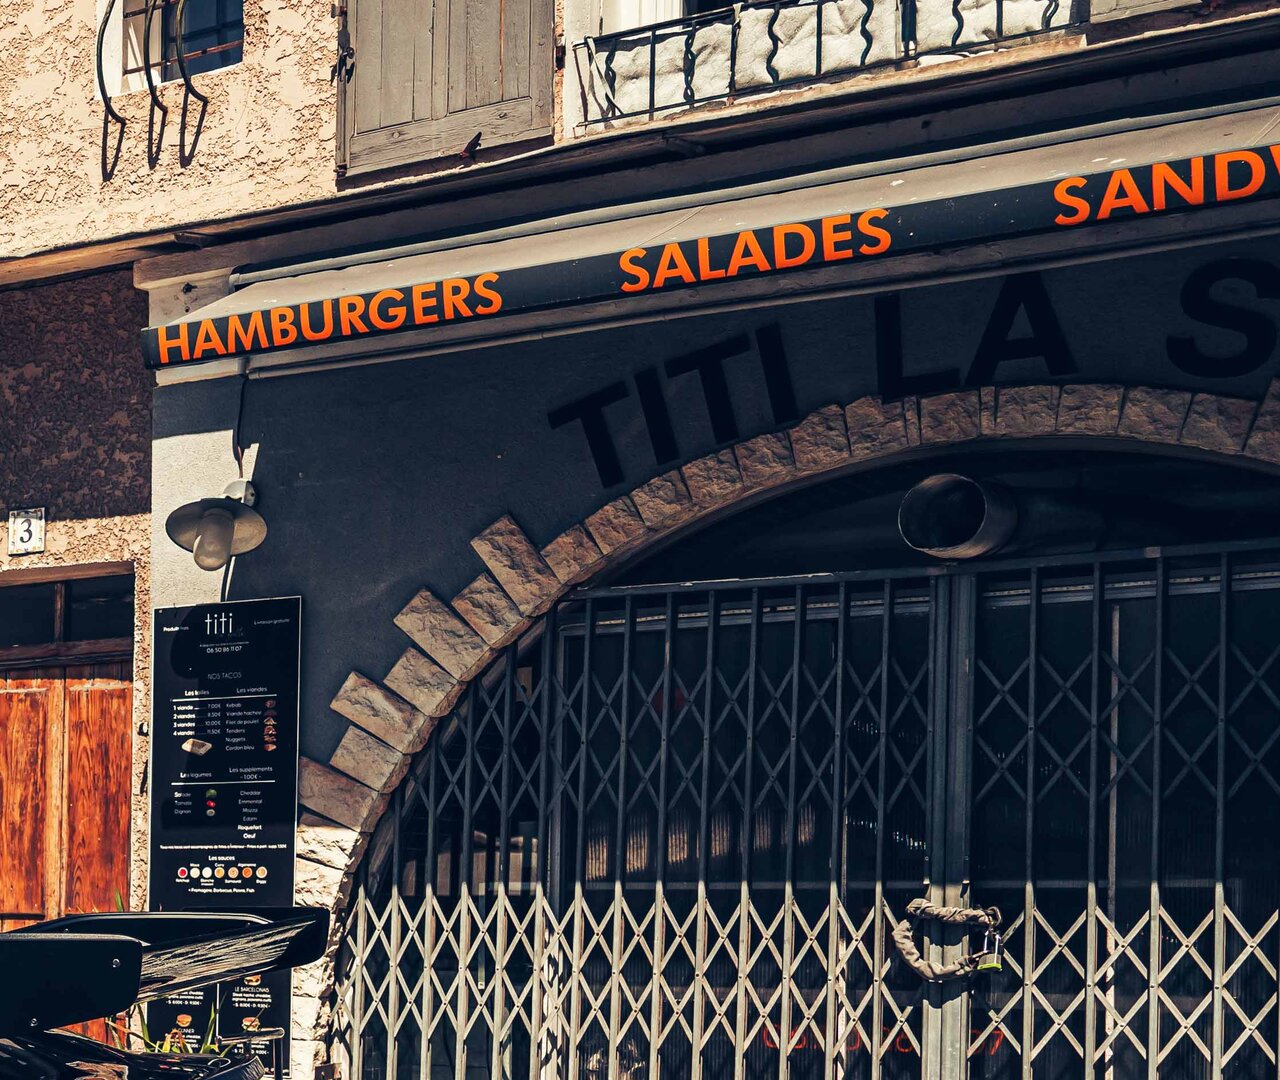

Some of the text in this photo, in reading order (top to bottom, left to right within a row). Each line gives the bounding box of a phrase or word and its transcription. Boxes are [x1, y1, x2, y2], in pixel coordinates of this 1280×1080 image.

[157, 272, 503, 364] HAMBURGERS
[619, 207, 892, 293] SALADES
[548, 322, 800, 489] TITI
[874, 271, 1079, 397] LA
[19, 518, 33, 544] 3
[204, 612, 233, 635] titi
[221, 671, 242, 679] TACOS
